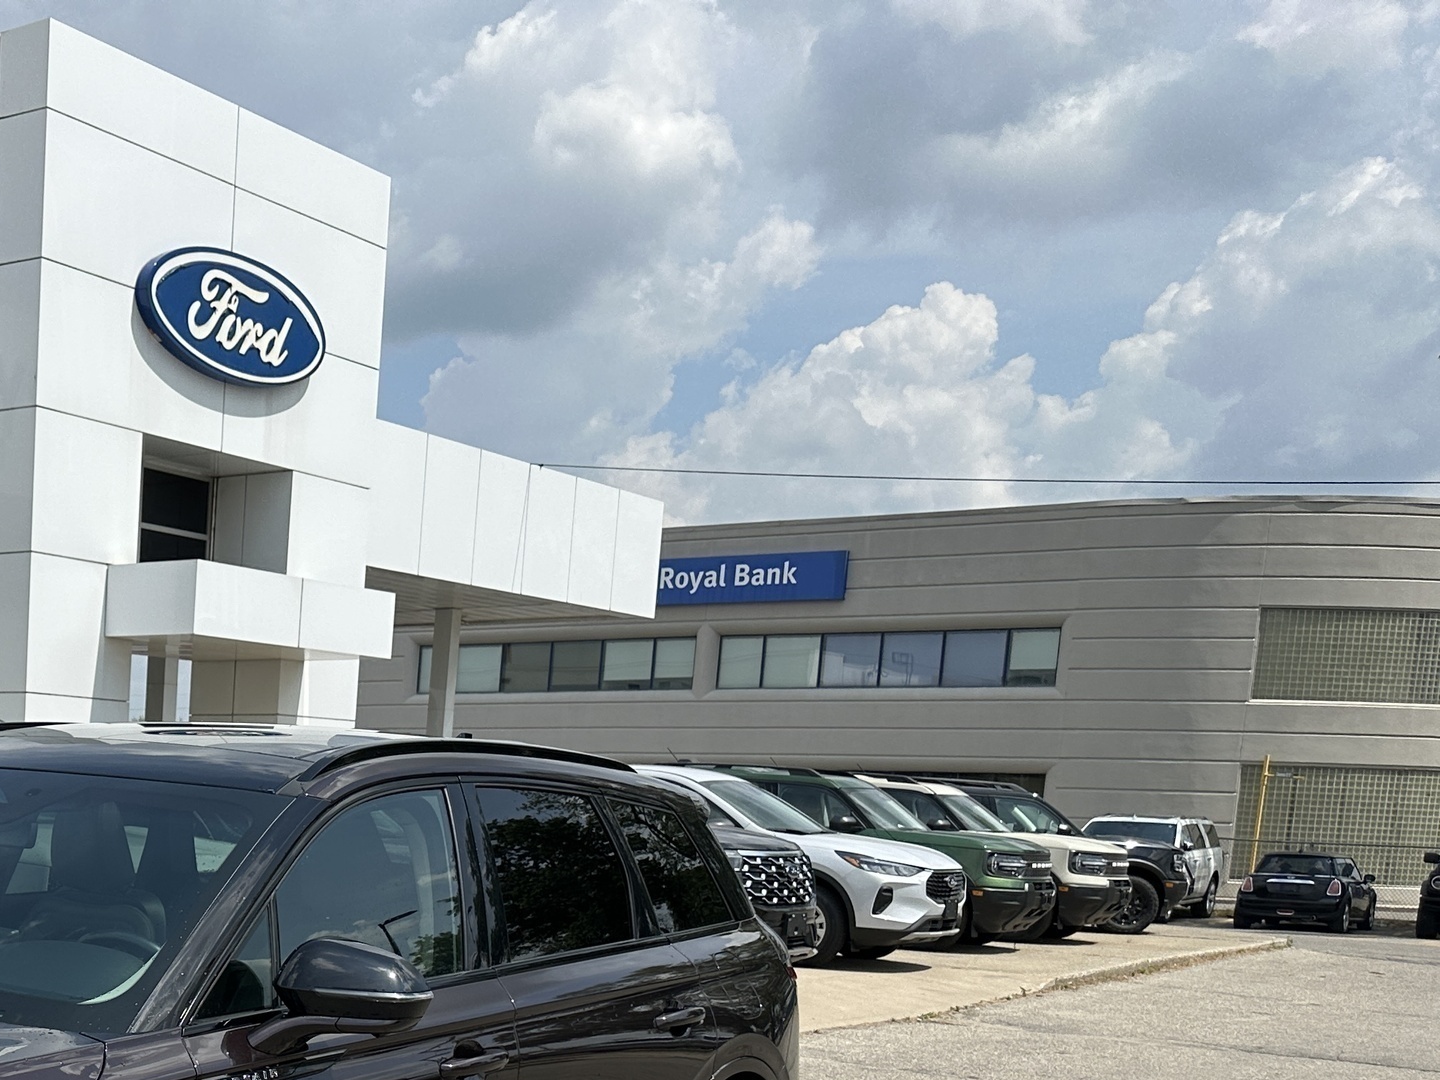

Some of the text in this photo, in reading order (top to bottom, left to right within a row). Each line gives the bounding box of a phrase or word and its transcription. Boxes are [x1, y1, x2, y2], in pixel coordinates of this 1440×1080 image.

[188, 268, 293, 368] Ford
[659, 560, 797, 594] Royal Bank
